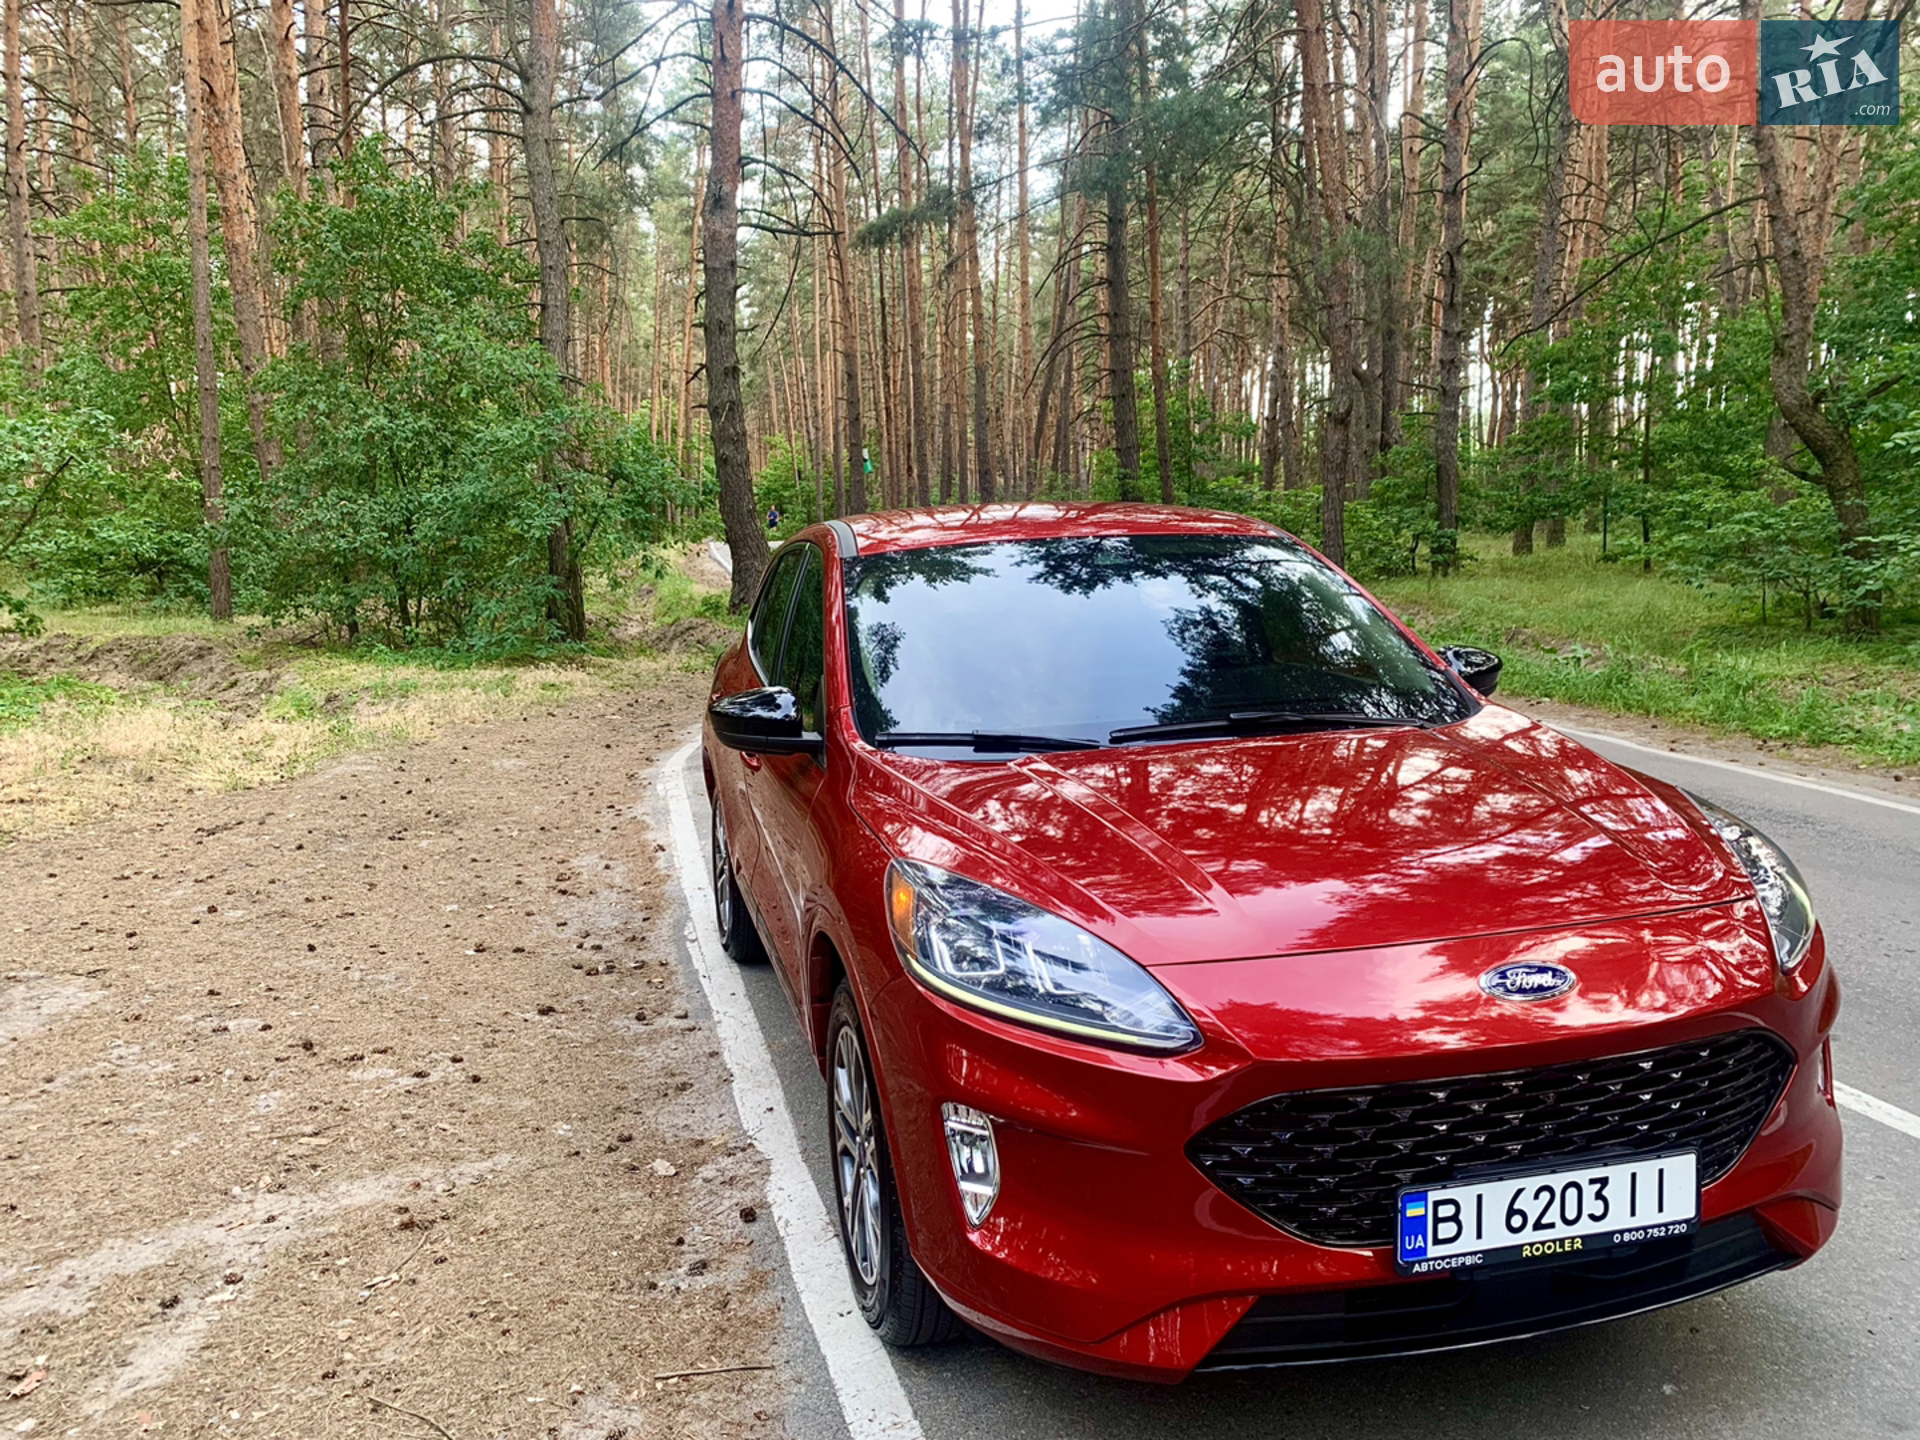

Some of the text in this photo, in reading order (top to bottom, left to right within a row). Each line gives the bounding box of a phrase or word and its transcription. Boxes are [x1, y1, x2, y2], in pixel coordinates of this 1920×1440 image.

[1498, 967, 1560, 992] Ford
[1431, 1167, 1665, 1247] BI 6203 II
[1405, 1234, 1425, 1250] UA
[1623, 1230, 1645, 1242] 800
[1646, 1226, 1667, 1239] 752
[1667, 1223, 1688, 1235] 720
[1522, 1237, 1584, 1258] ROOLER
